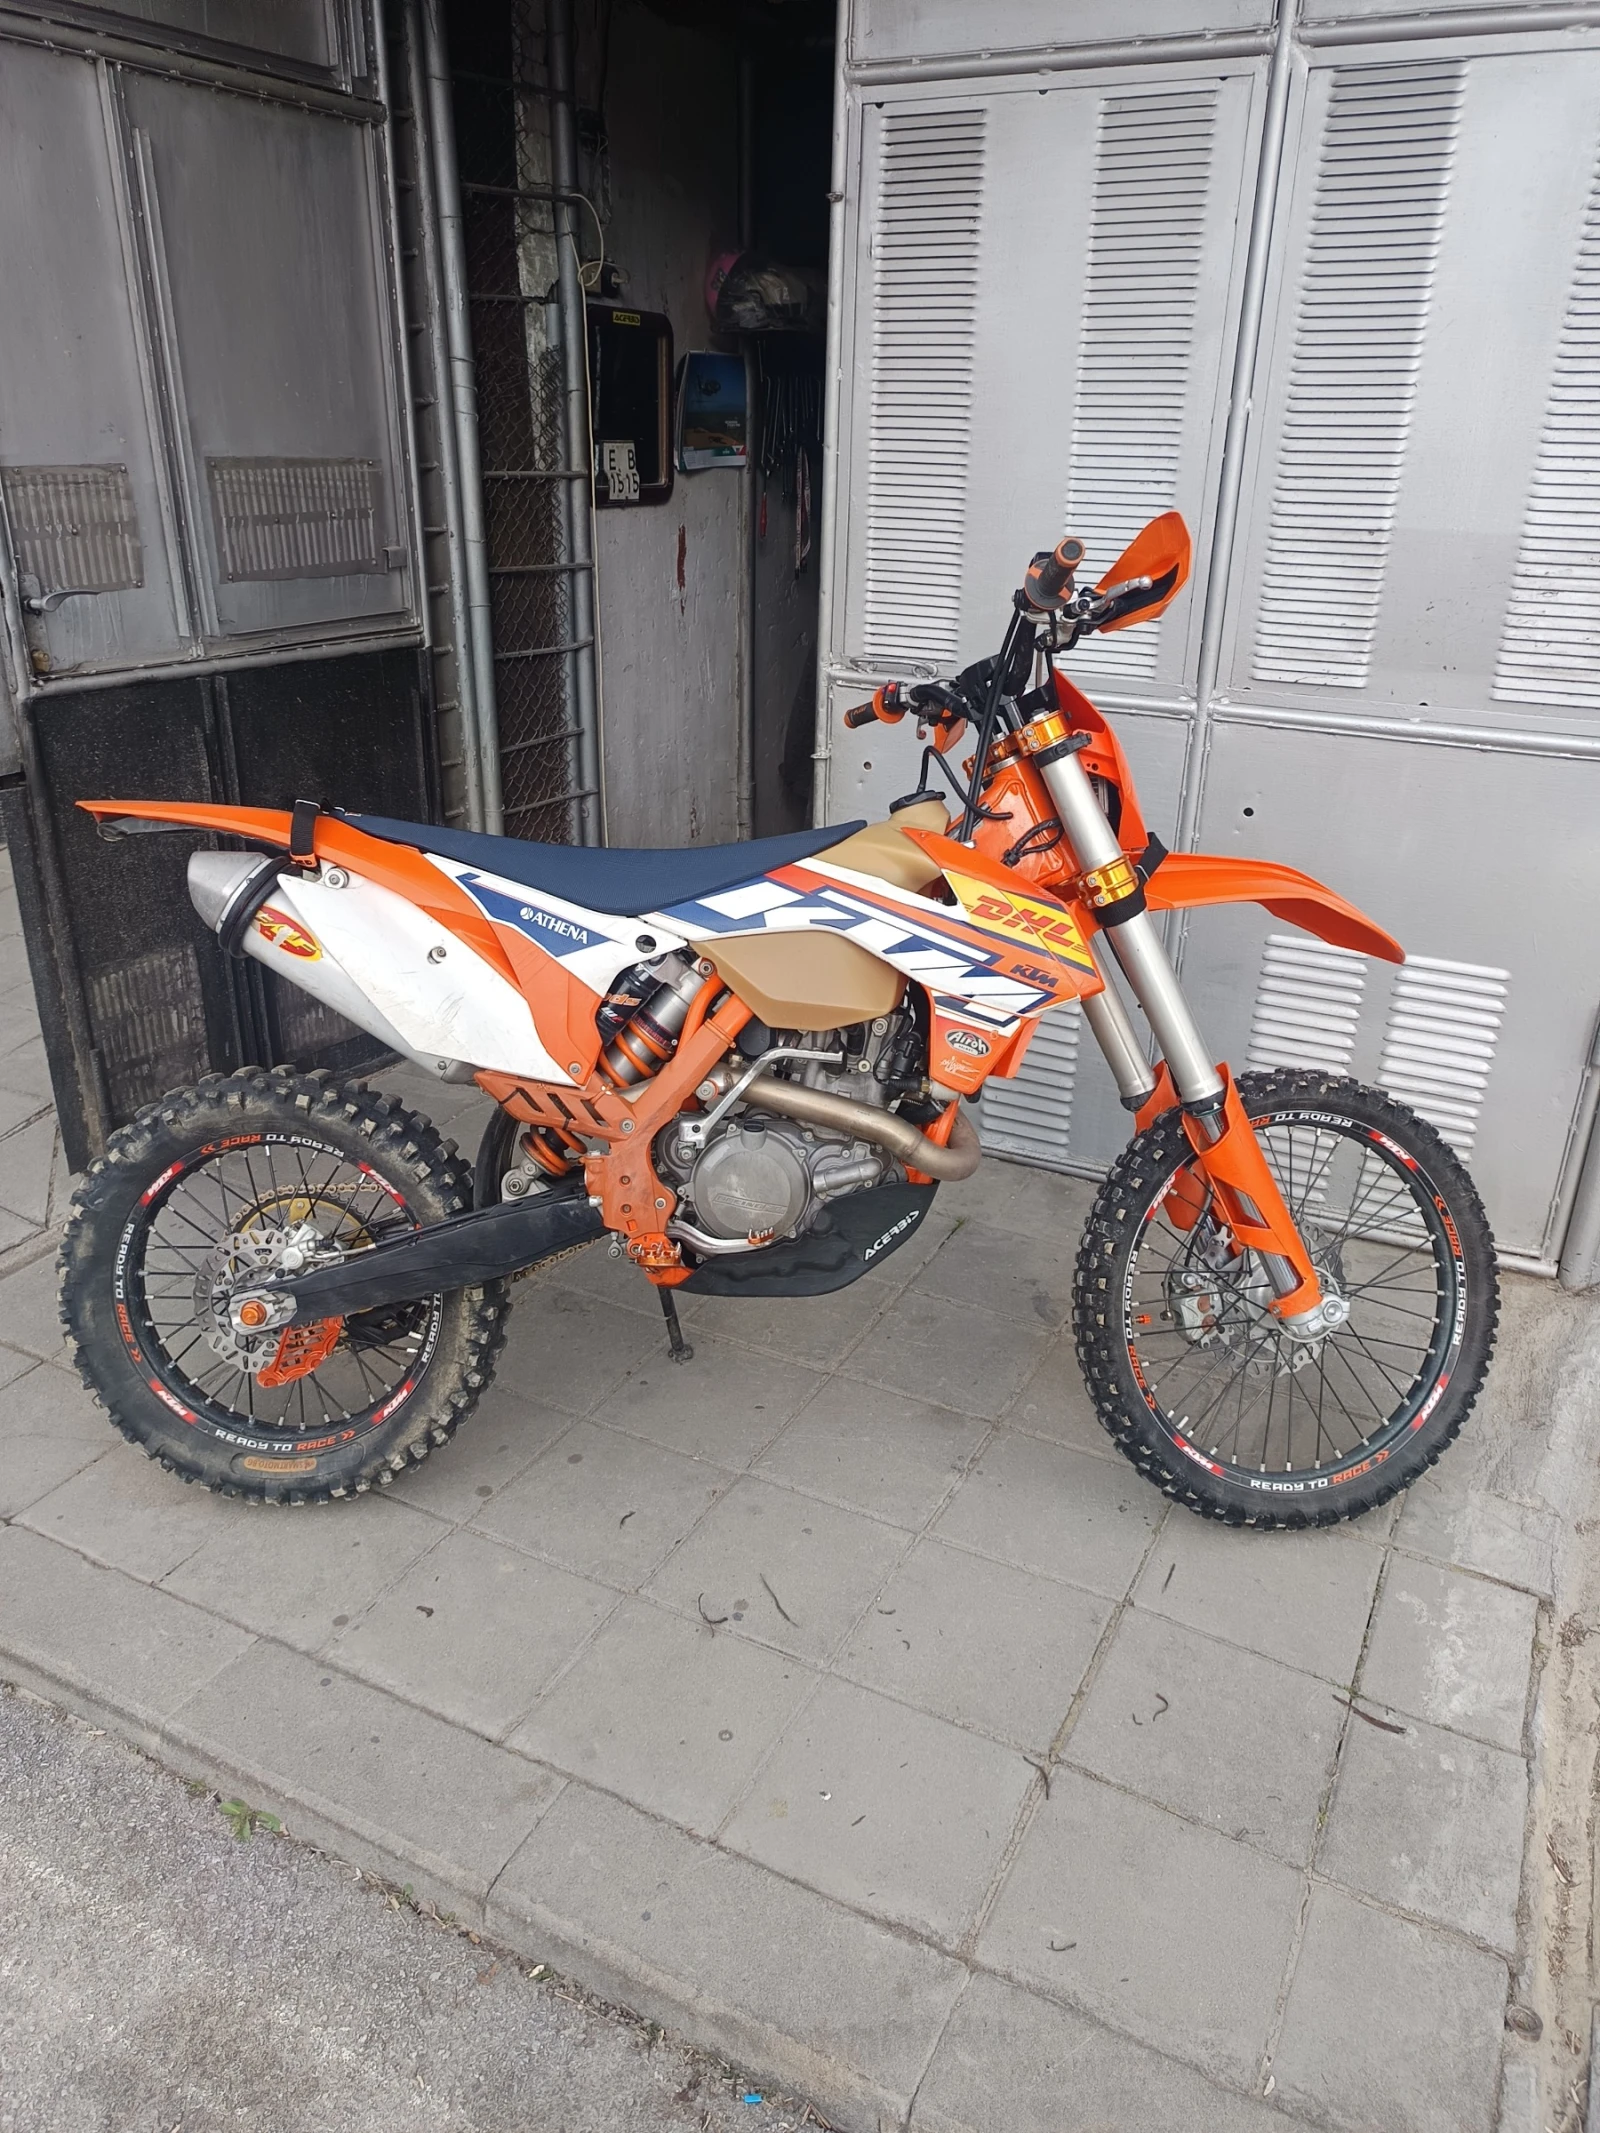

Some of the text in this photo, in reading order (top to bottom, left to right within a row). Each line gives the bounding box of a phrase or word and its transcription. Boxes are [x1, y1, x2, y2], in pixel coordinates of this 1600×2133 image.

[611, 472, 639, 494] 1515
[531, 911, 588, 945] ATHENA
[970, 895, 1075, 947] DHL
[1009, 963, 1060, 988] KTM
[948, 1031, 987, 1054] Airoh
[1275, 1113, 1294, 1122] TO
[1300, 1112, 1353, 1128] READY
[220, 1133, 261, 1149] RACE
[288, 1135, 344, 1158] READY
[863, 1209, 921, 1262] ACERBIS
[115, 1222, 136, 1343] READY TO RACE
[1443, 1215, 1466, 1345] READY TO RACE
[1125, 1250, 1147, 1389] READY TO RACE
[421, 1310, 440, 1363] READY
[214, 1429, 337, 1451] READY TO RACE
[1250, 1460, 1371, 1491] READY TO RACE
